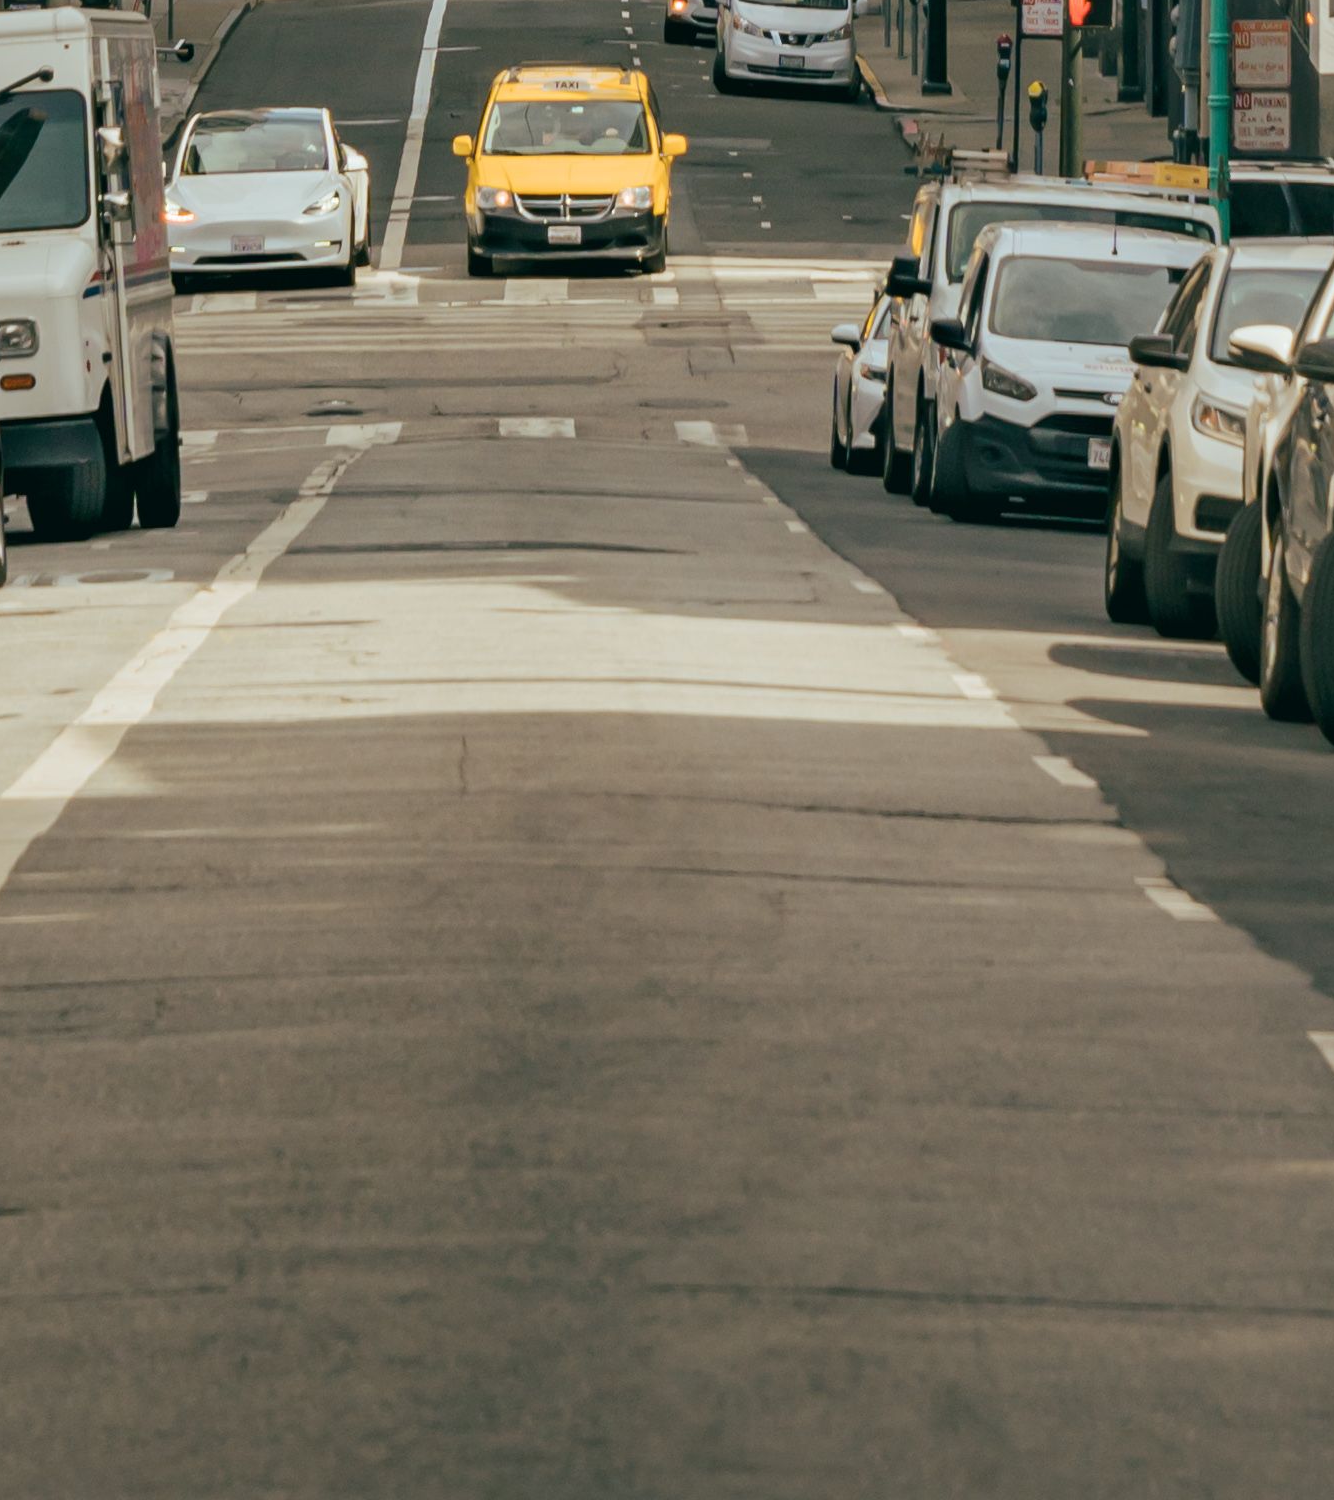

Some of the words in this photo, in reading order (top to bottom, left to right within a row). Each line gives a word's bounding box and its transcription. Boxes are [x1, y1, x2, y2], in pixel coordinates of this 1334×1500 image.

[1236, 31, 1250, 46] NO
[554, 80, 580, 90] TAXI
[1235, 93, 1250, 108] NO
